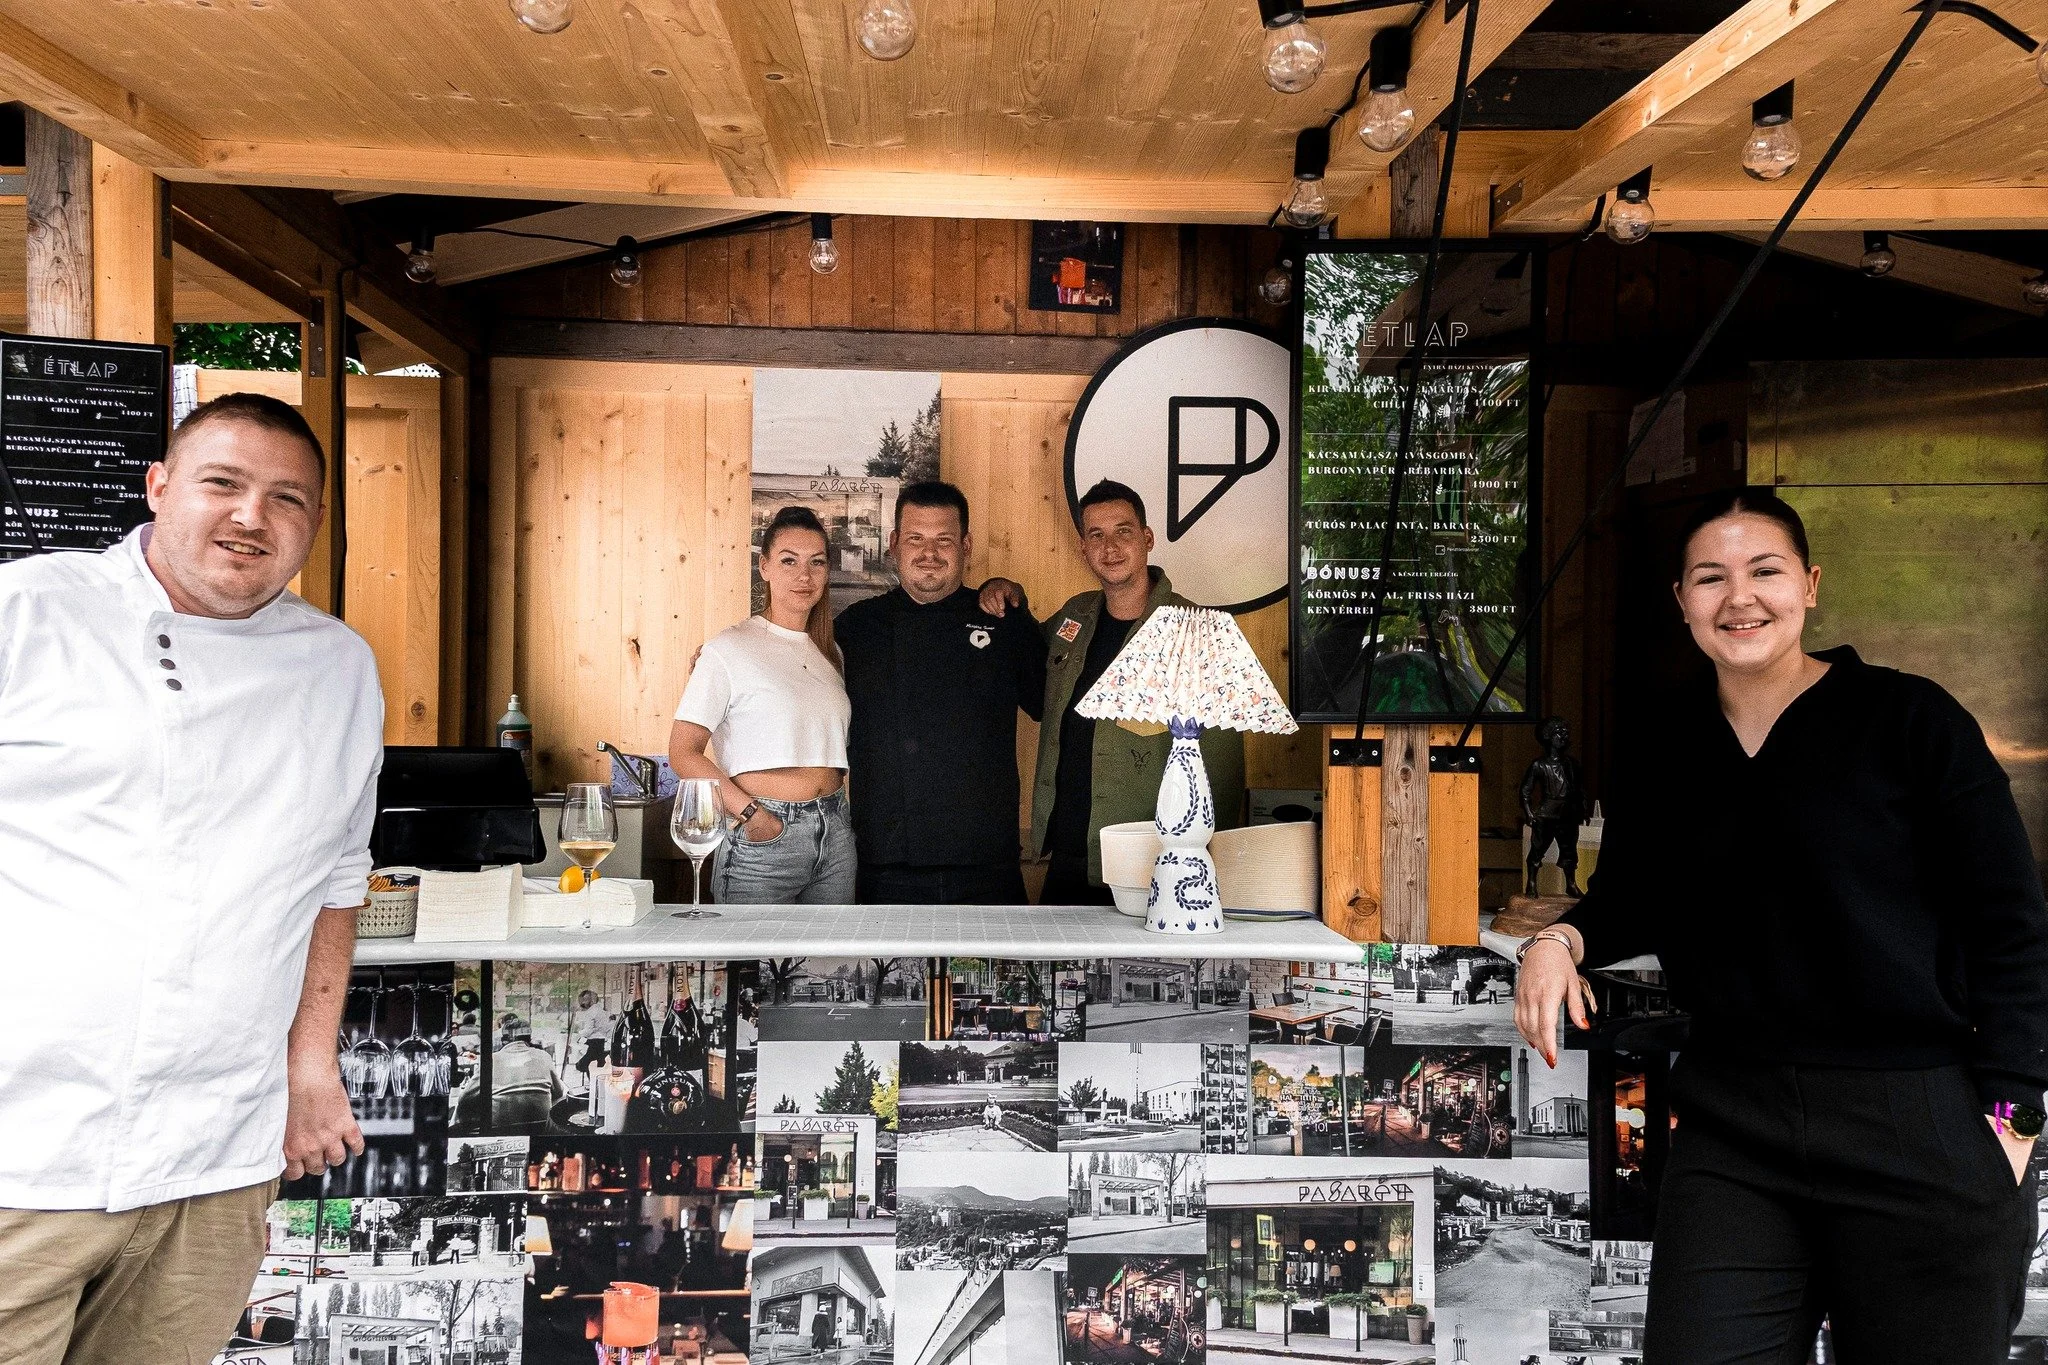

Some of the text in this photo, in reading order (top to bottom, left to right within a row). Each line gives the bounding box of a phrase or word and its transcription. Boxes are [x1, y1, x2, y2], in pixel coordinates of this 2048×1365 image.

[44, 355, 118, 378] ÉTLAP
[1506, 399, 1521, 407] FT
[1504, 481, 1519, 489] FT
[1307, 519, 1480, 531] TÚRÓS PALACINTA, BARACK
[1503, 535, 1518, 543] FT
[1307, 564, 1381, 580] BÓNUSZ
[1307, 589, 1475, 600] KÖRMÖS PAAL, FRISS HÁZI
[1469, 605, 1517, 613] 3800 FT
